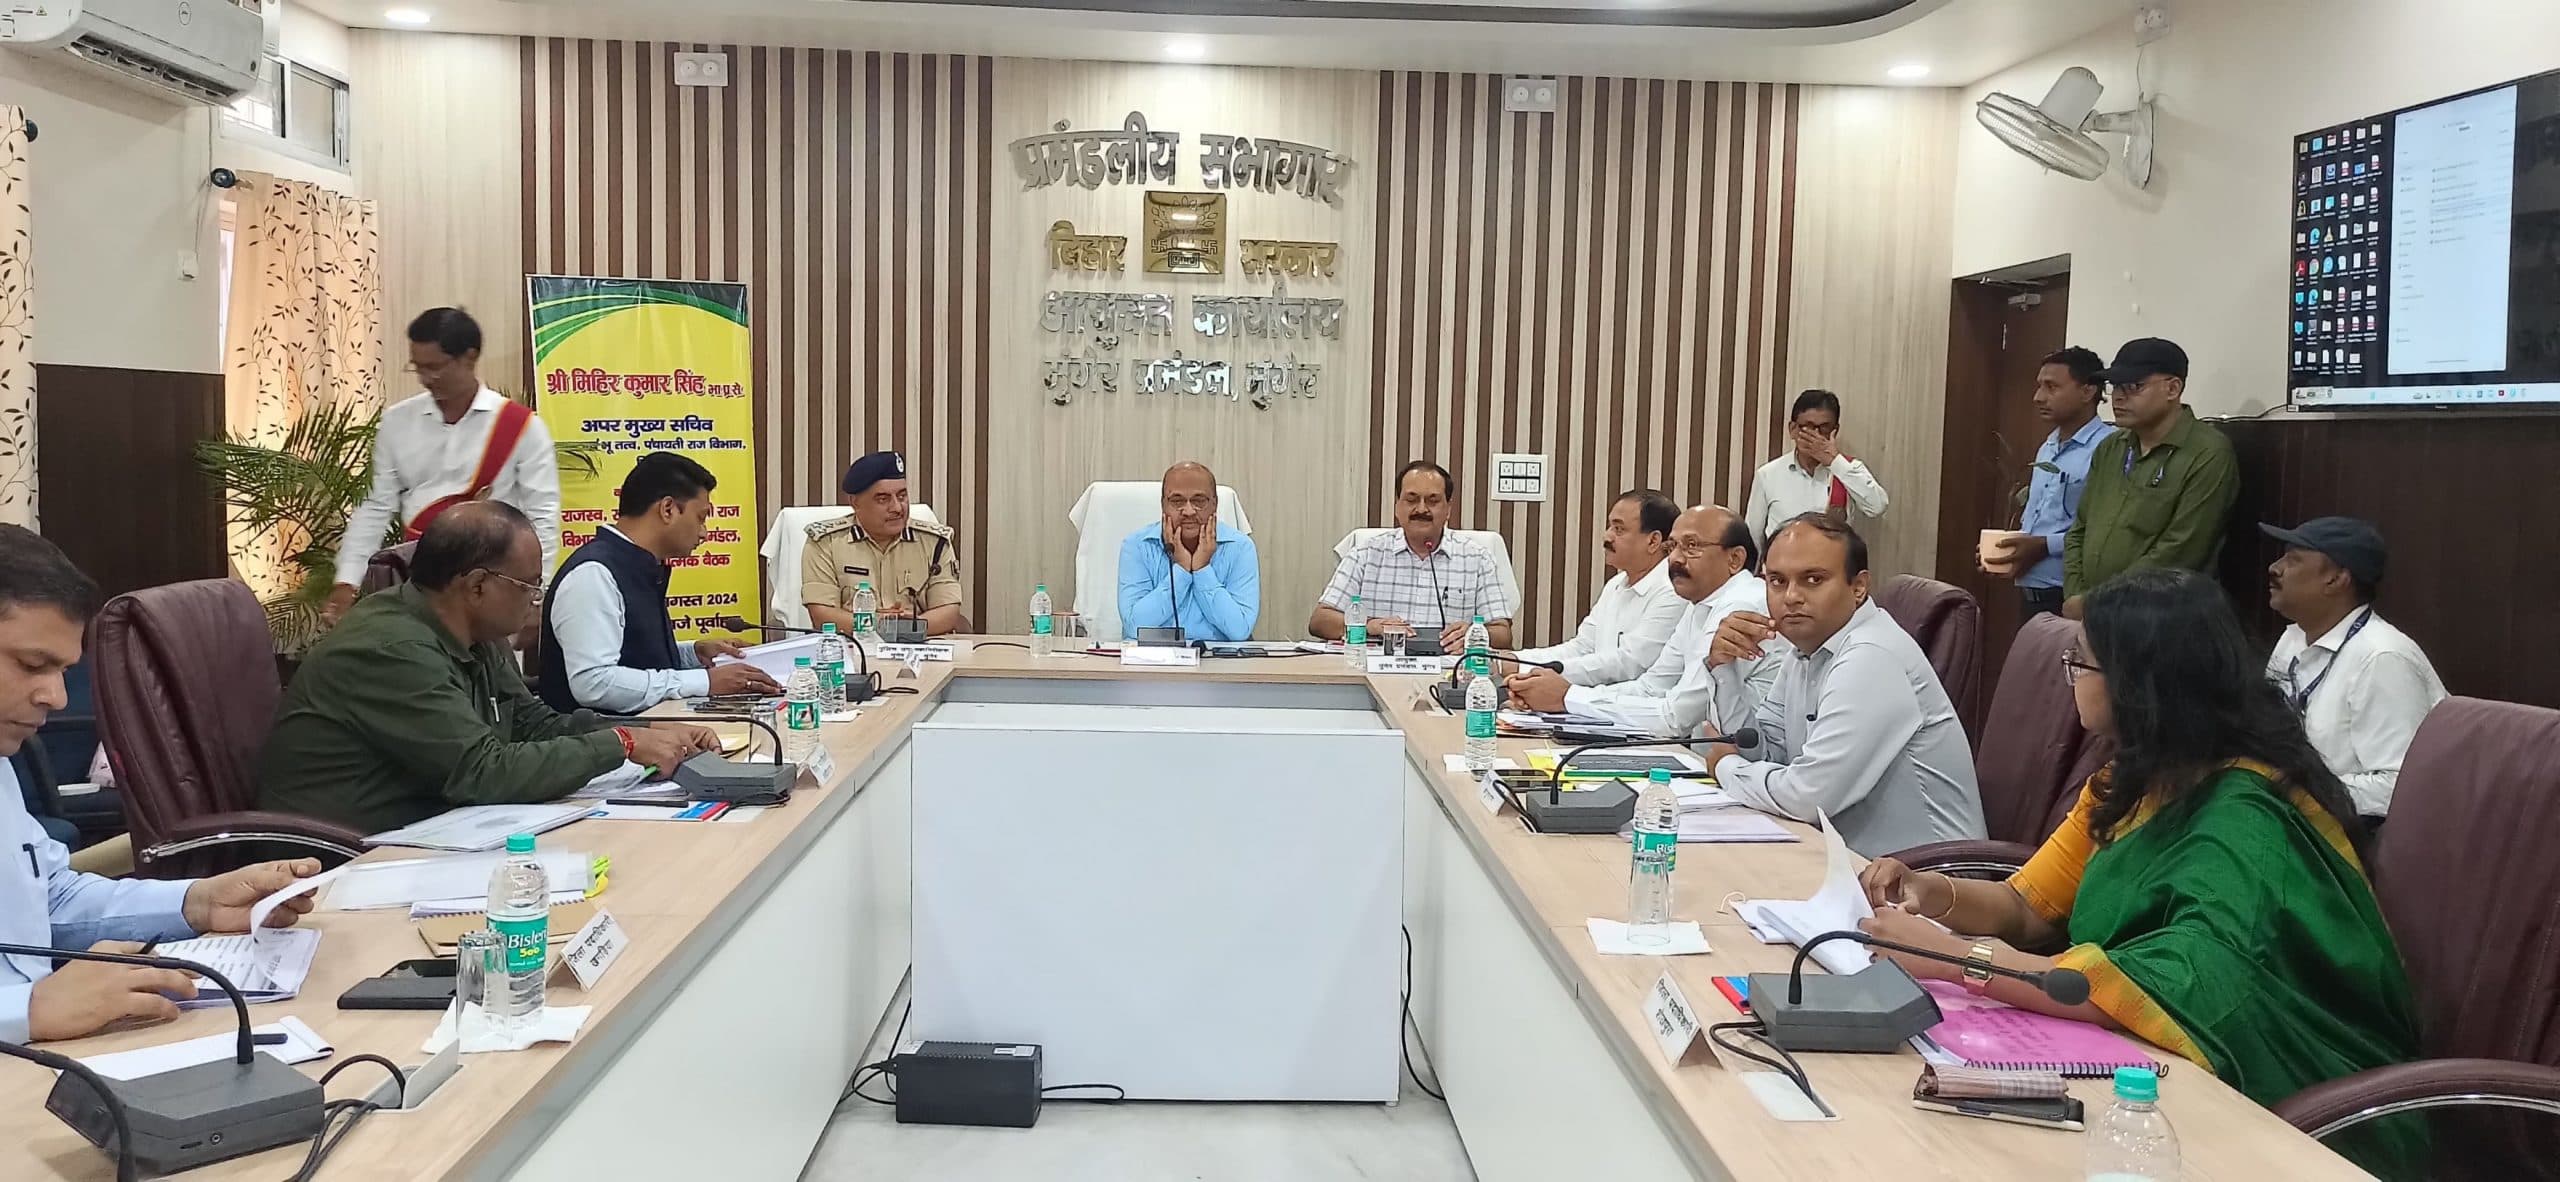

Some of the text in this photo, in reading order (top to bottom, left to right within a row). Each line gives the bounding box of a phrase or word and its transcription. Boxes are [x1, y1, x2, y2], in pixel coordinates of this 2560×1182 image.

[1009, 111, 1356, 204] प्रमंडलीय सभागार
[1048, 220, 1338, 277] बिहार सरकार
[1040, 282, 1344, 350] आयुक्त कार्यालय
[547, 369, 568, 396] श्री
[572, 368, 621, 396] मिहिर
[624, 374, 672, 399] कुमार
[674, 369, 706, 397] सिंह
[581, 415, 713, 438] अपर मुख्य सचिव
[644, 438, 684, 450] पंचायती
[688, 439, 706, 450] राज
[717, 506, 740, 518] राज
[703, 527, 741, 543] मंडल,
[702, 551, 731, 567] बैठक
[707, 593, 738, 606] 2024
